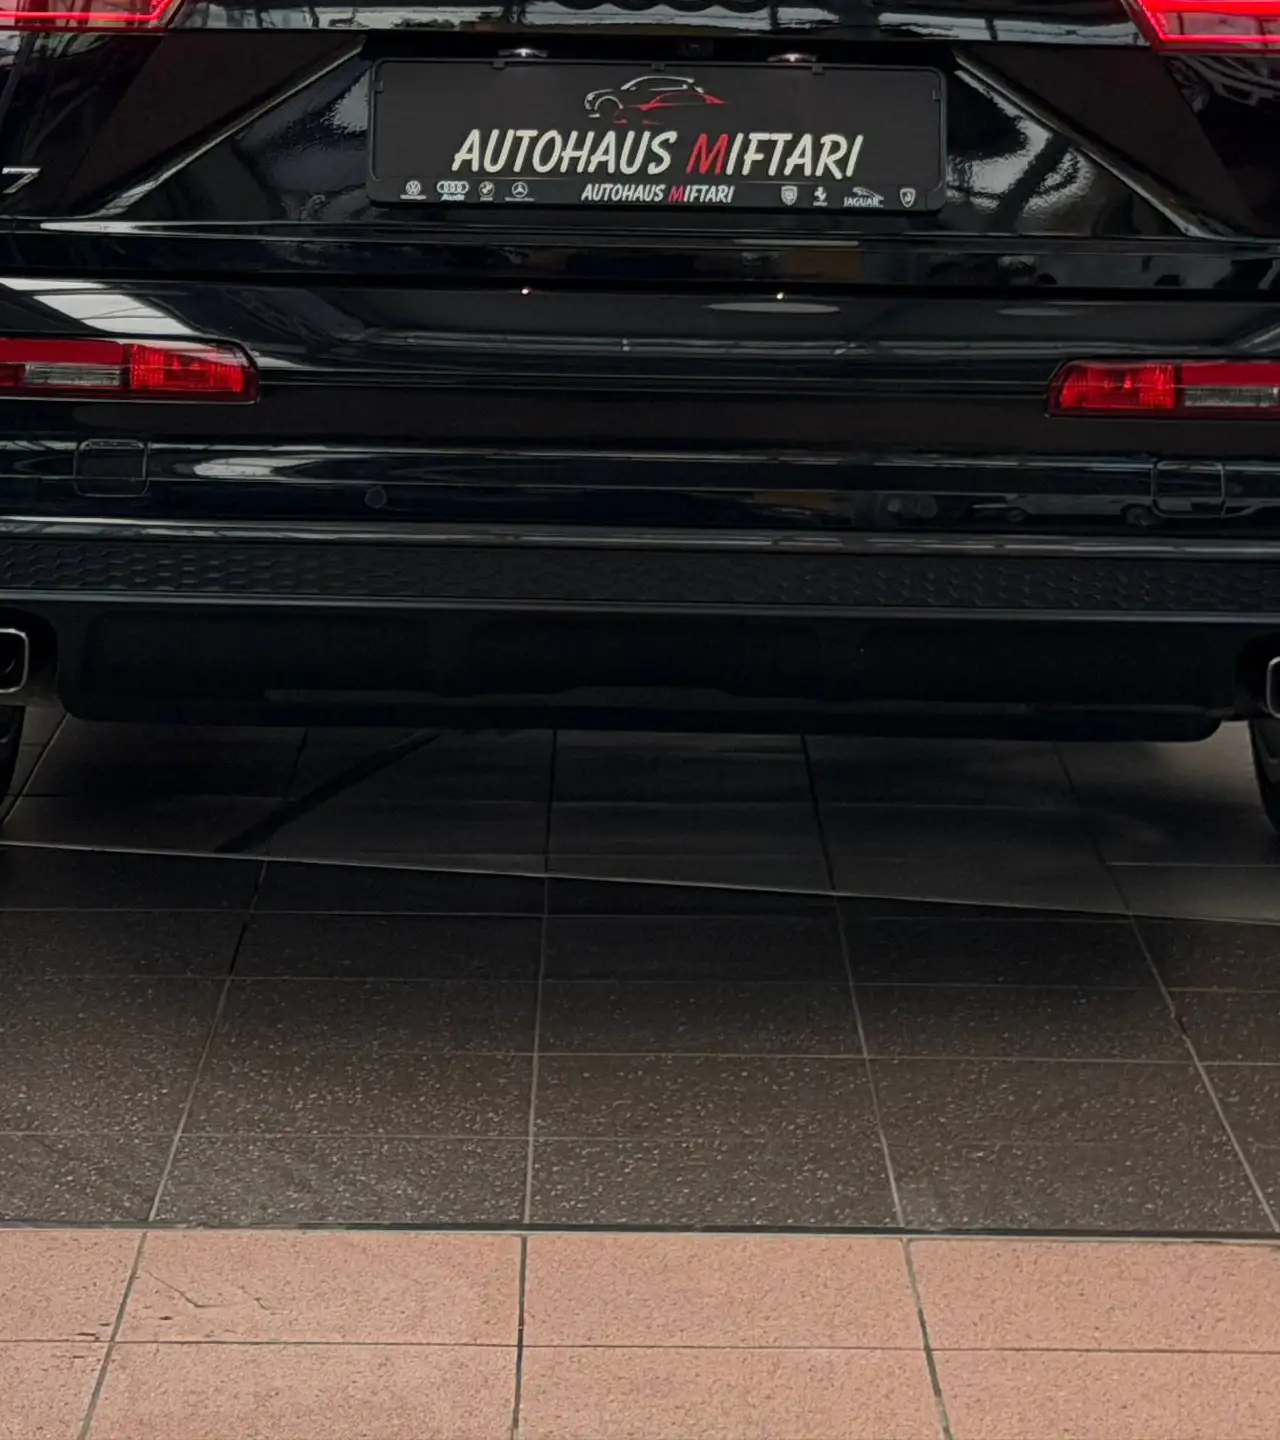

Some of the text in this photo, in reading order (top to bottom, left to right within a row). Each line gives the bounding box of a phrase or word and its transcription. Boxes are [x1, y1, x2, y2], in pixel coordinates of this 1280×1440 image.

[451, 129, 864, 180] AUTOHAUS MIFTARI
[580, 184, 735, 205] AUTOHAUS MIFTARI
